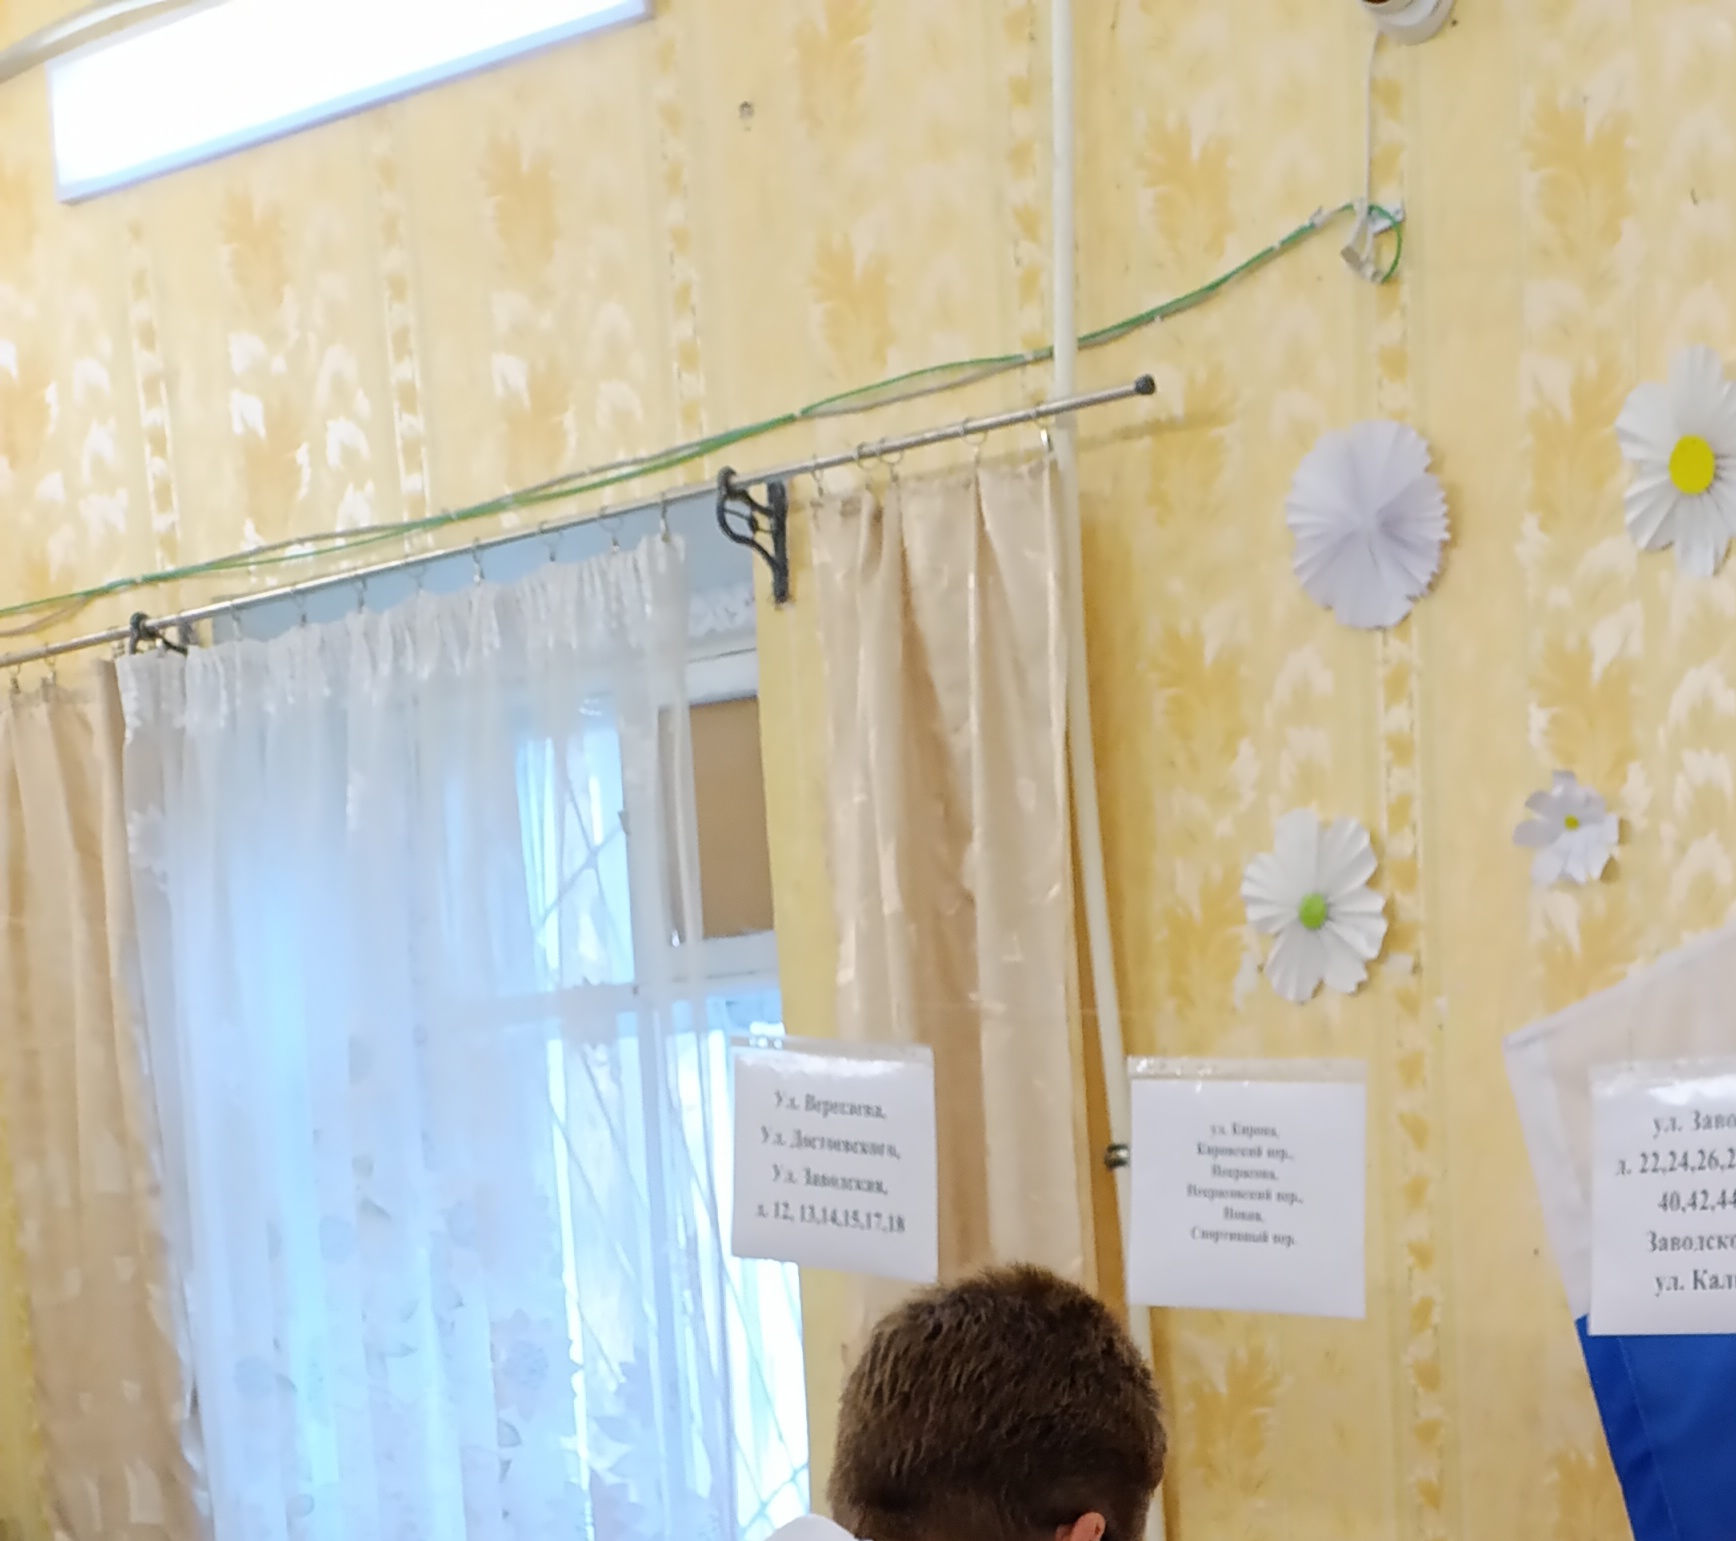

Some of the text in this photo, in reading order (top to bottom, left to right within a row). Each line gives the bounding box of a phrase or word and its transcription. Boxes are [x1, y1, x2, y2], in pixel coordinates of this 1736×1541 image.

[1652, 1116, 1683, 1139] ул.
[1615, 1159, 1632, 1177] д.
[1655, 1274, 1685, 1297] ул.
